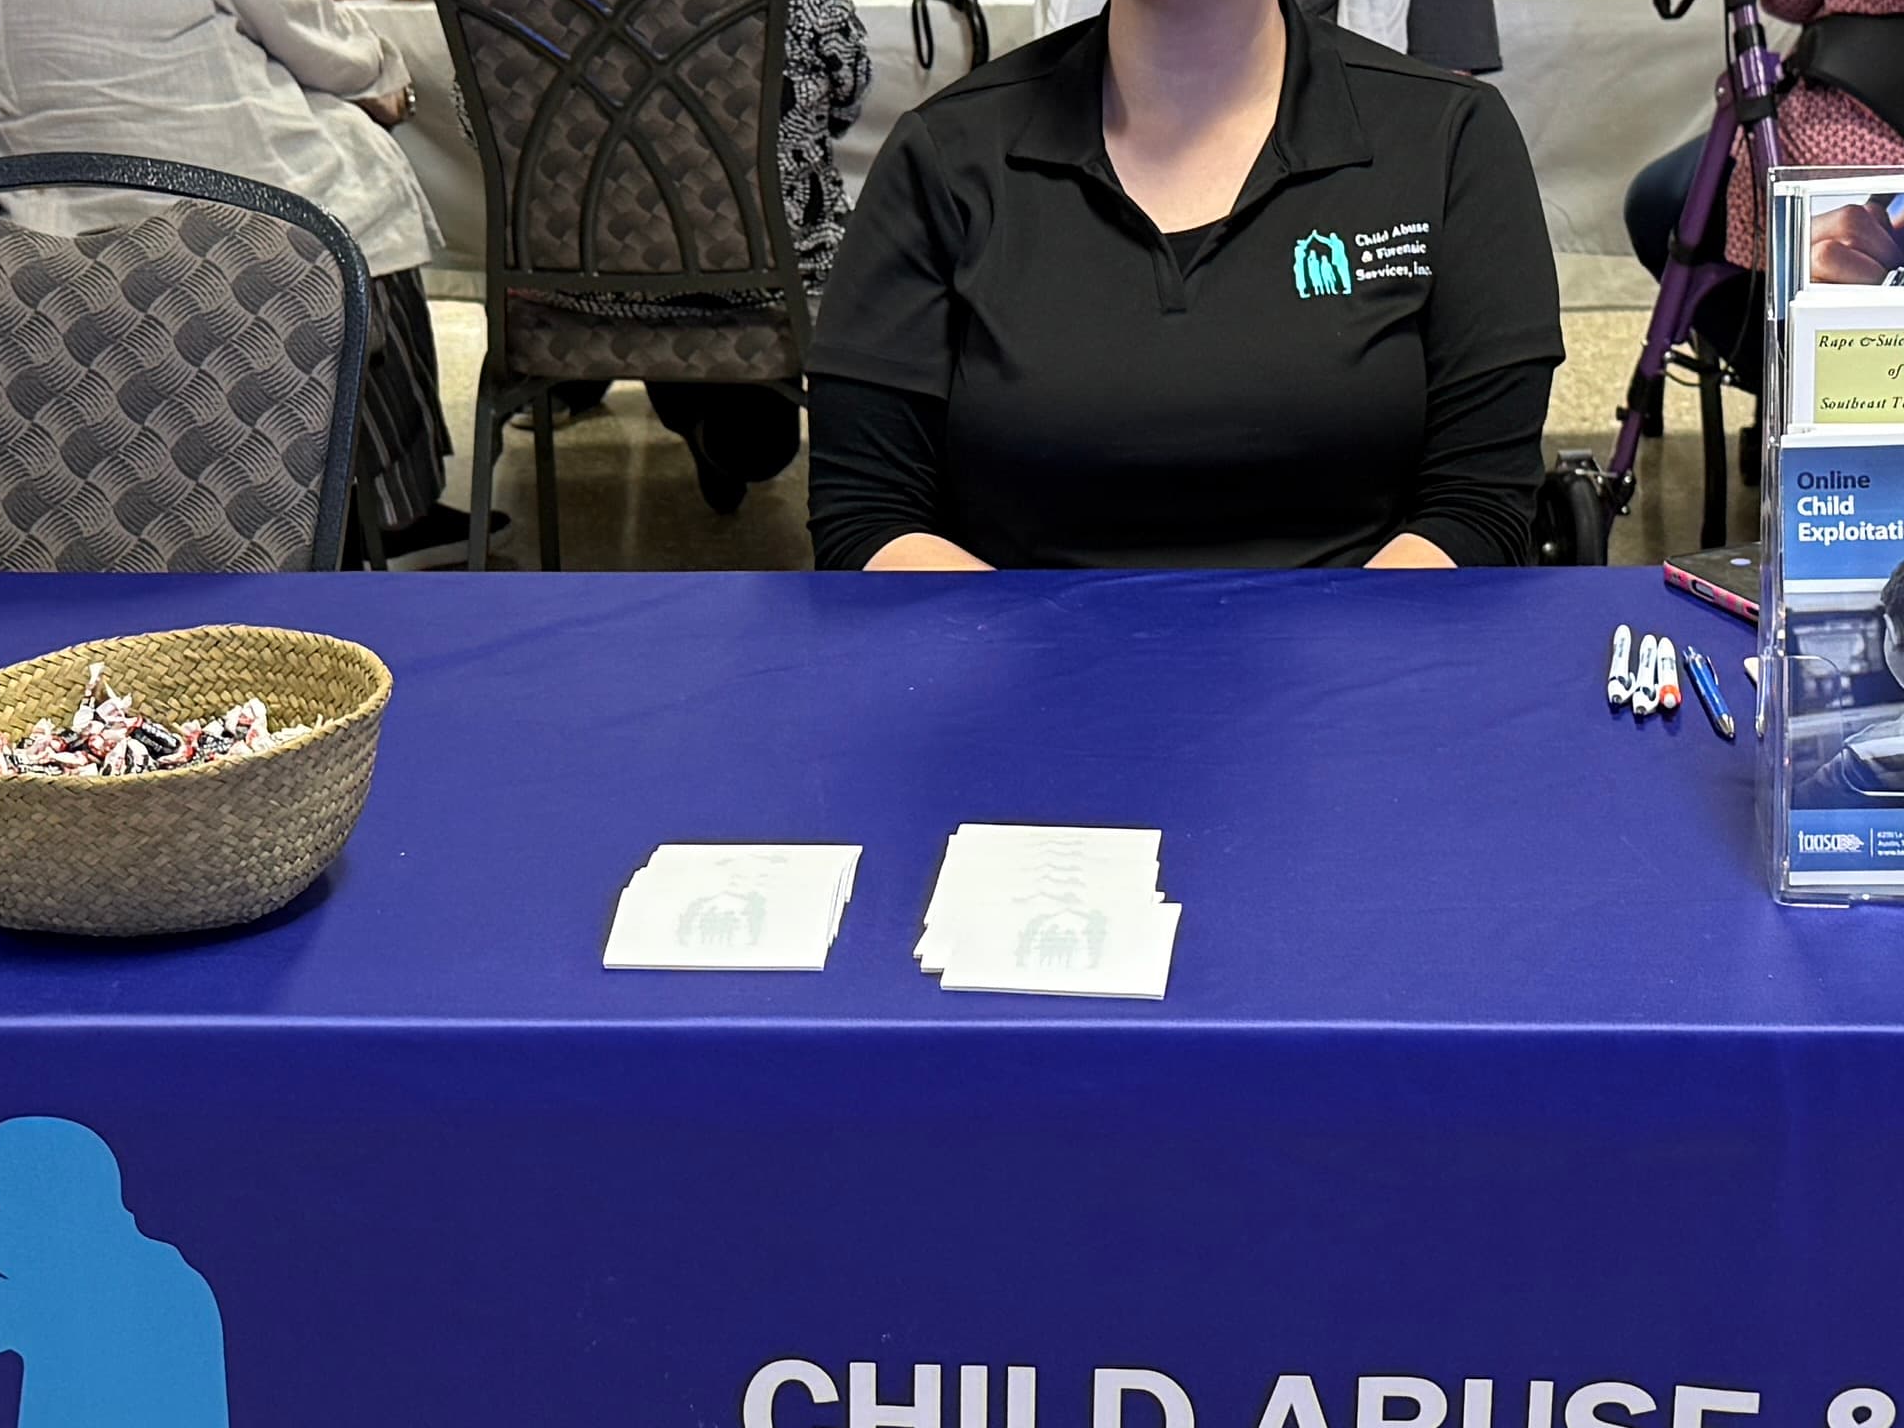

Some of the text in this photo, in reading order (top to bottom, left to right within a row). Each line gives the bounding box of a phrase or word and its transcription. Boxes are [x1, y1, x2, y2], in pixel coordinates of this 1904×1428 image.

[1354, 222, 1430, 247] Child Abuse
[1361, 240, 1427, 263] & Forensic
[1355, 263, 1413, 282] Services,
[1818, 333, 1855, 351] Rape
[1887, 362, 1904, 380] of
[1820, 396, 1887, 411] Southeast
[1797, 471, 1871, 490] Online
[1797, 495, 1855, 517] Child
